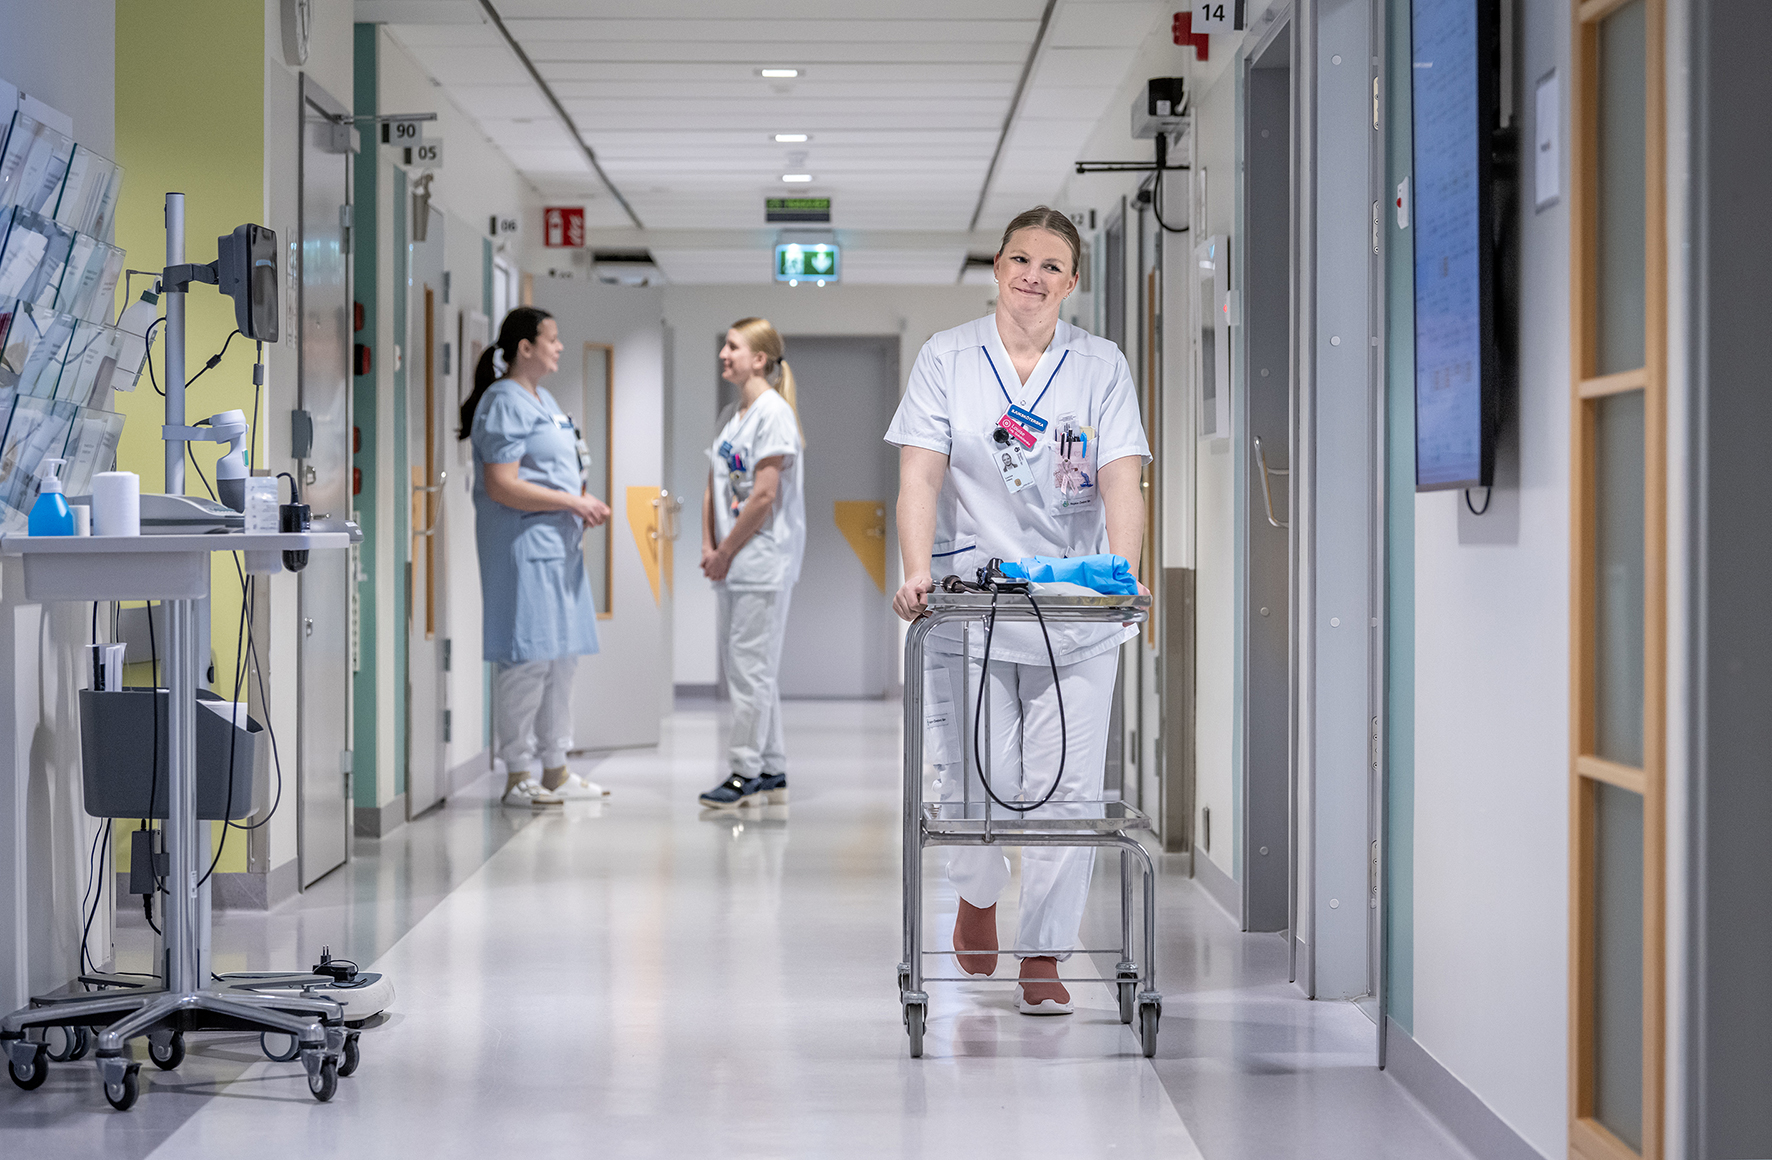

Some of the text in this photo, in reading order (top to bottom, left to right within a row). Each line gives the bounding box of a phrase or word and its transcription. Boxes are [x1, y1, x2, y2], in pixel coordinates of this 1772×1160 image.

[1202, 4, 1225, 21] 14
[397, 123, 415, 138] 90
[418, 145, 437, 161] 05
[1011, 423, 1026, 437] Louise
